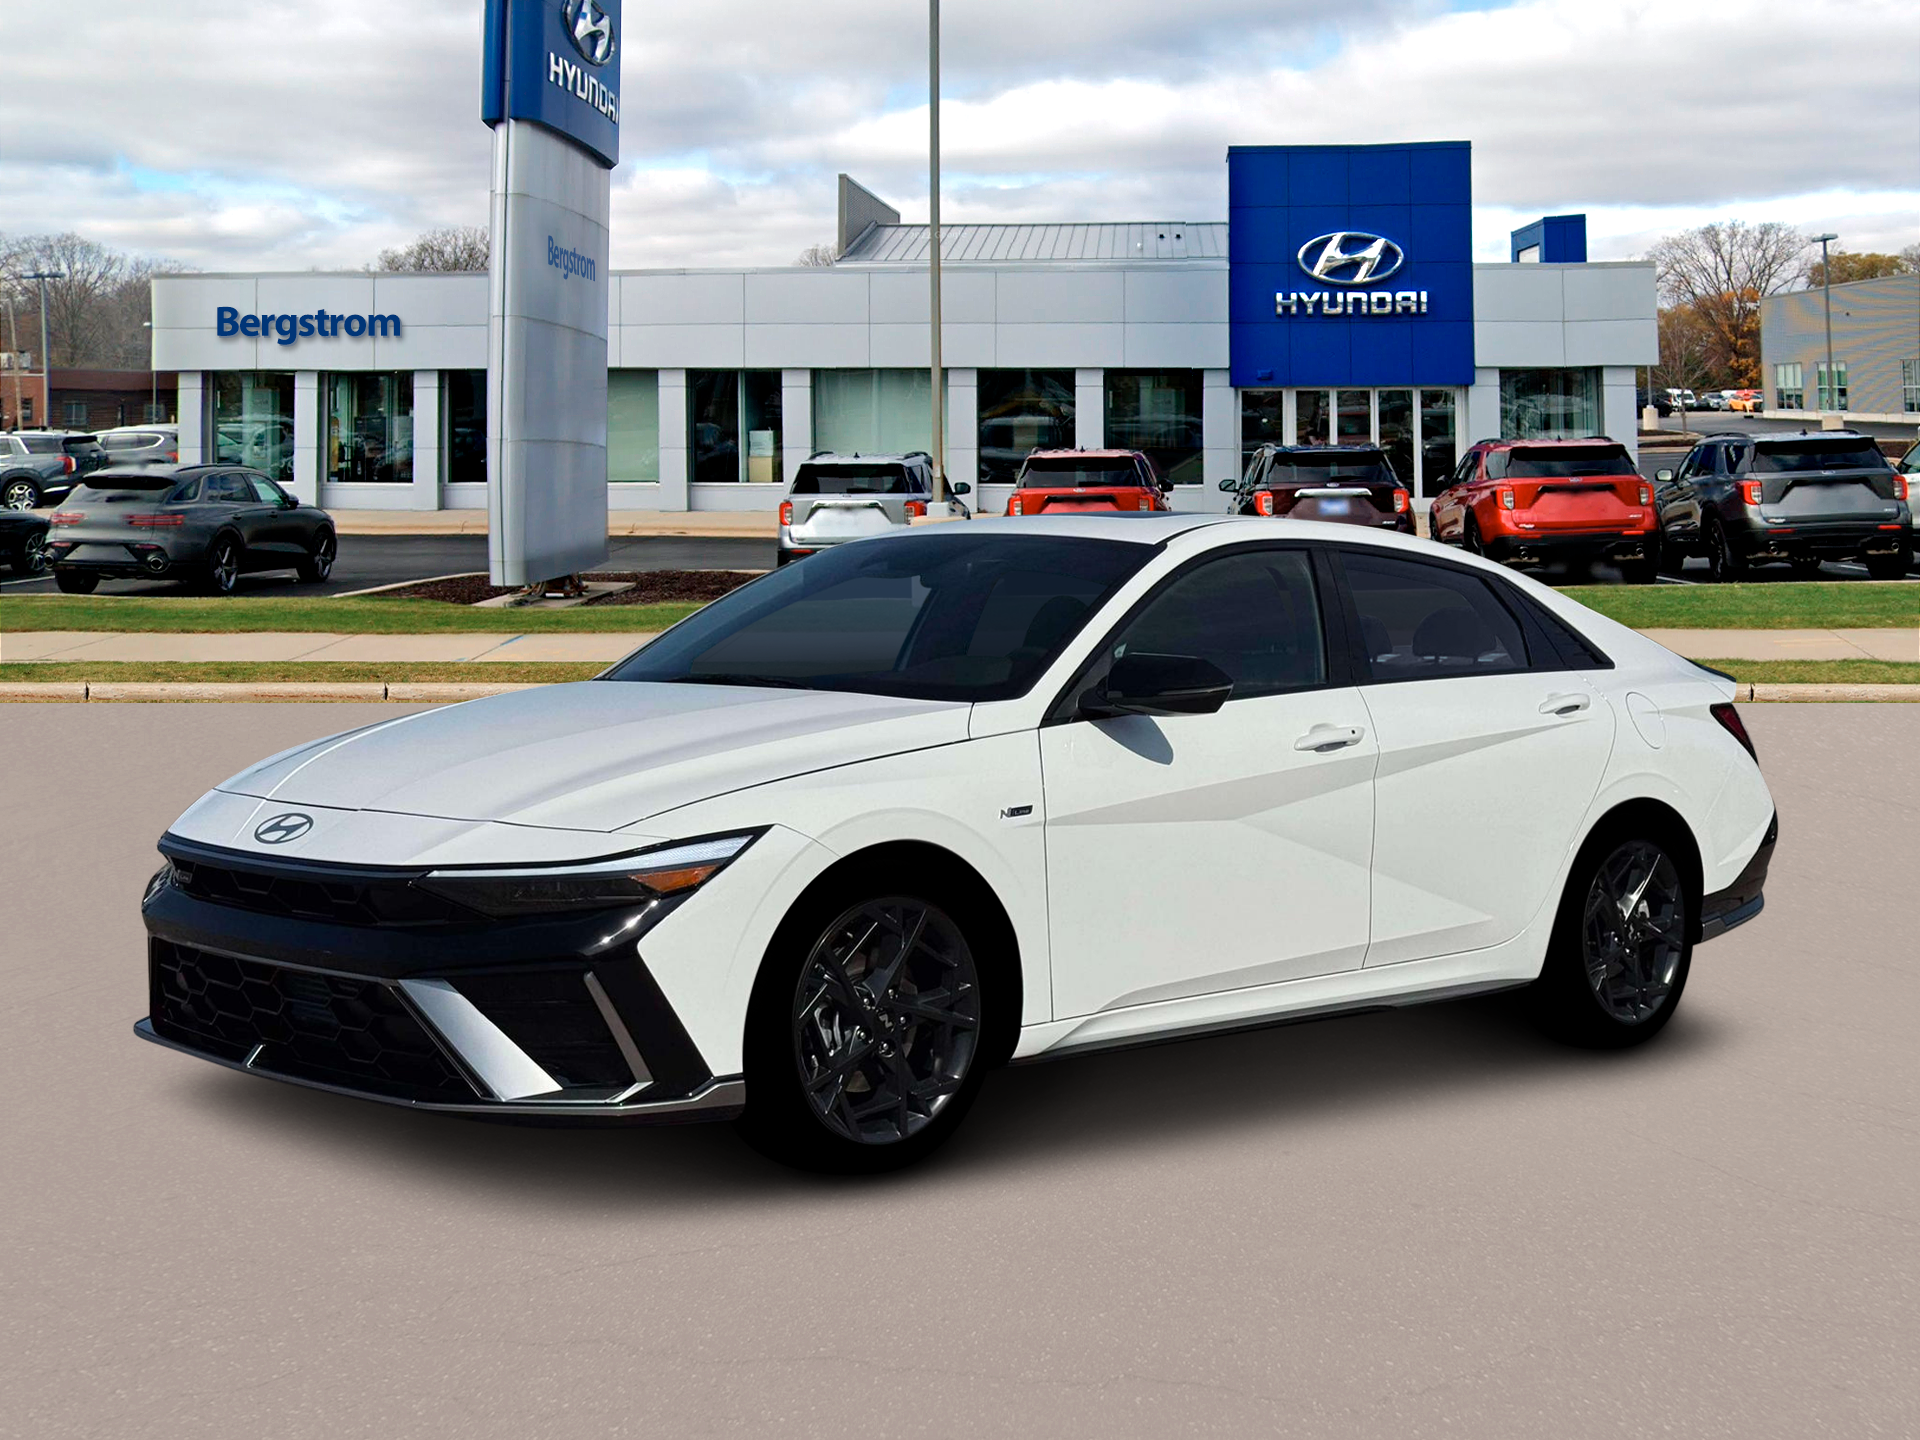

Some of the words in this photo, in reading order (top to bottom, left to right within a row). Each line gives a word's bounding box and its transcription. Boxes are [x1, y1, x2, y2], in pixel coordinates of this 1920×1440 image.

[549, 52, 619, 124] HYUNDAI
[547, 235, 596, 281] Bergstrom
[1275, 290, 1428, 315] HYUNDAI
[216, 306, 402, 346] Bergstrom
